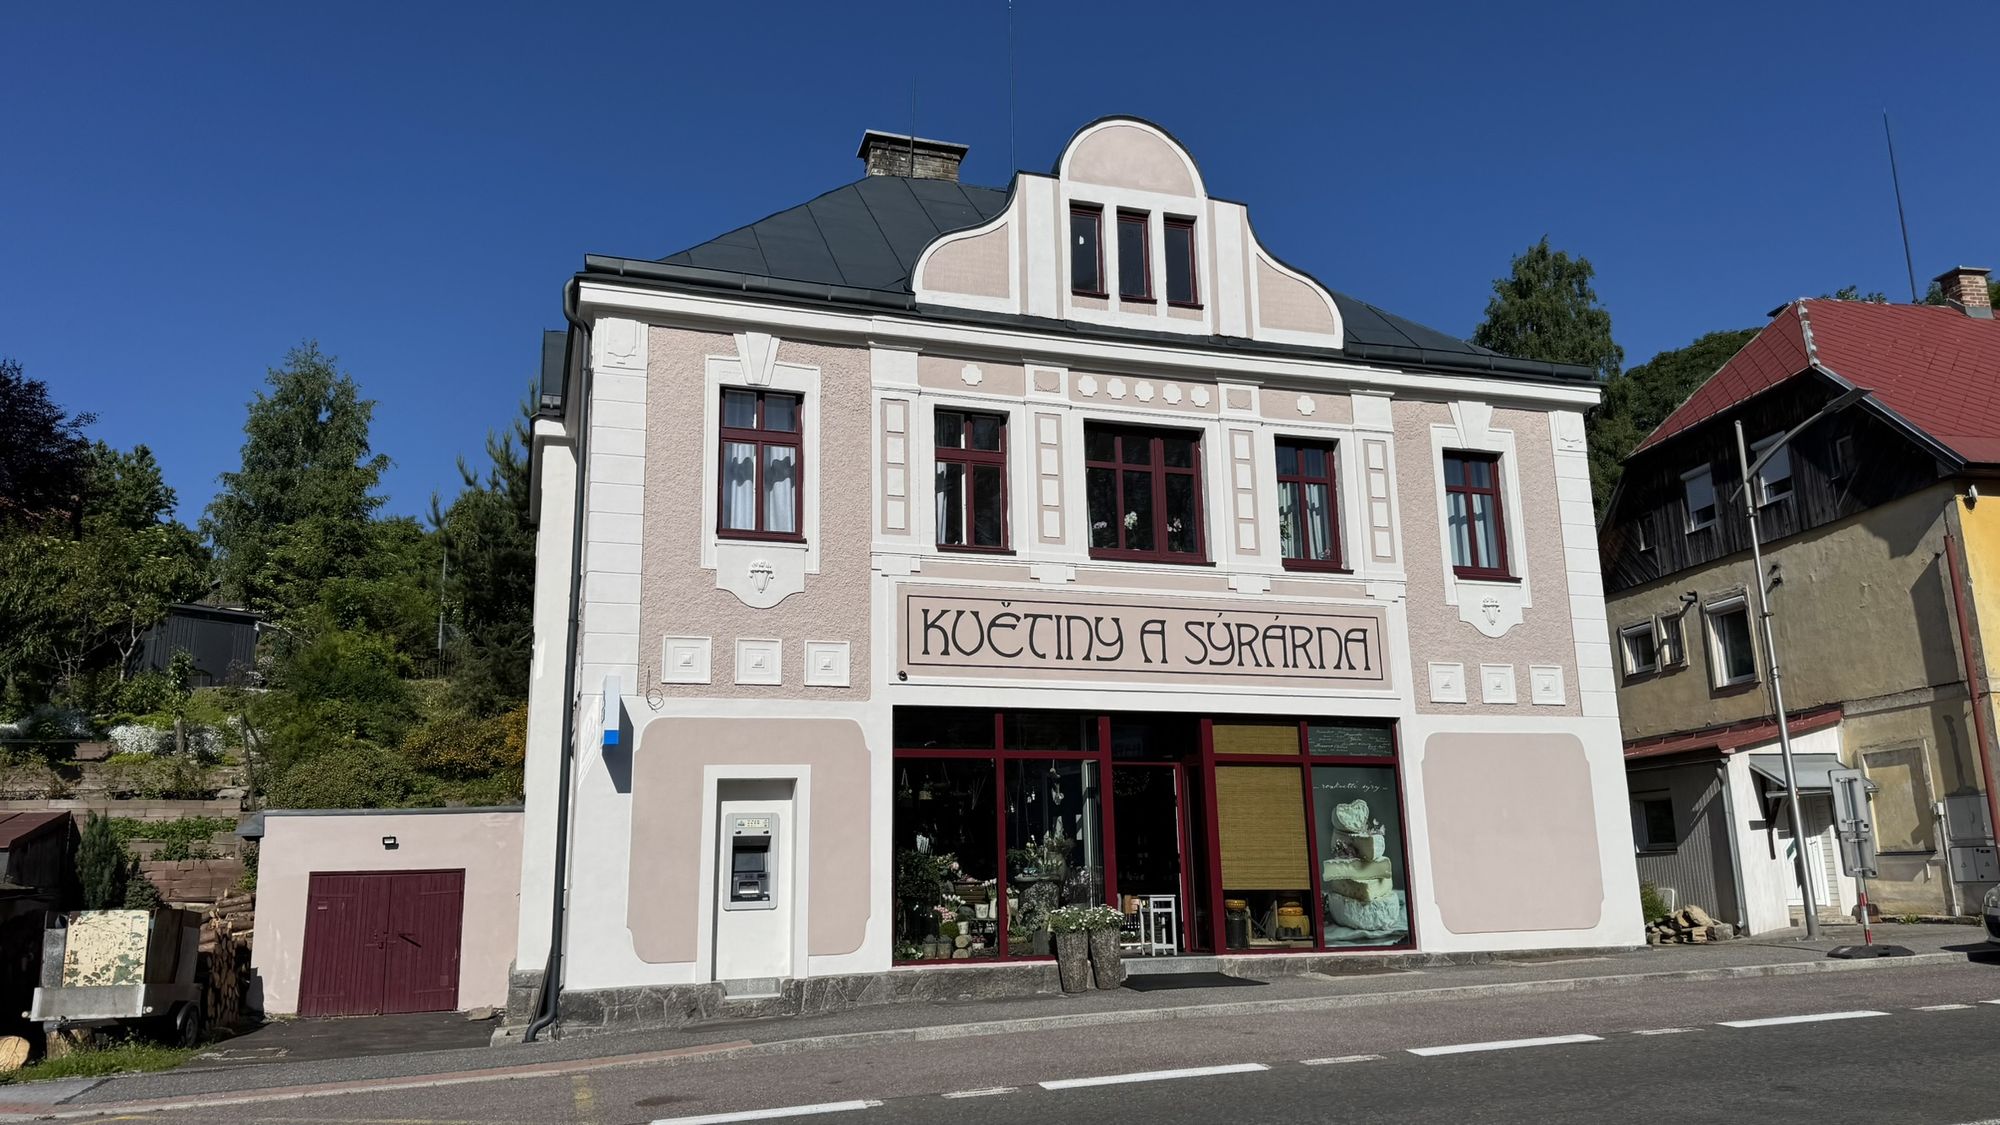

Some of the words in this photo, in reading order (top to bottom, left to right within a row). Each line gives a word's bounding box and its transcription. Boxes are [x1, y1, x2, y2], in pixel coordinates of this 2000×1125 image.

[921, 601, 1124, 662] KVĚTINY
[1139, 619, 1169, 664] A
[1184, 612, 1371, 671] SÝRÁRNA
